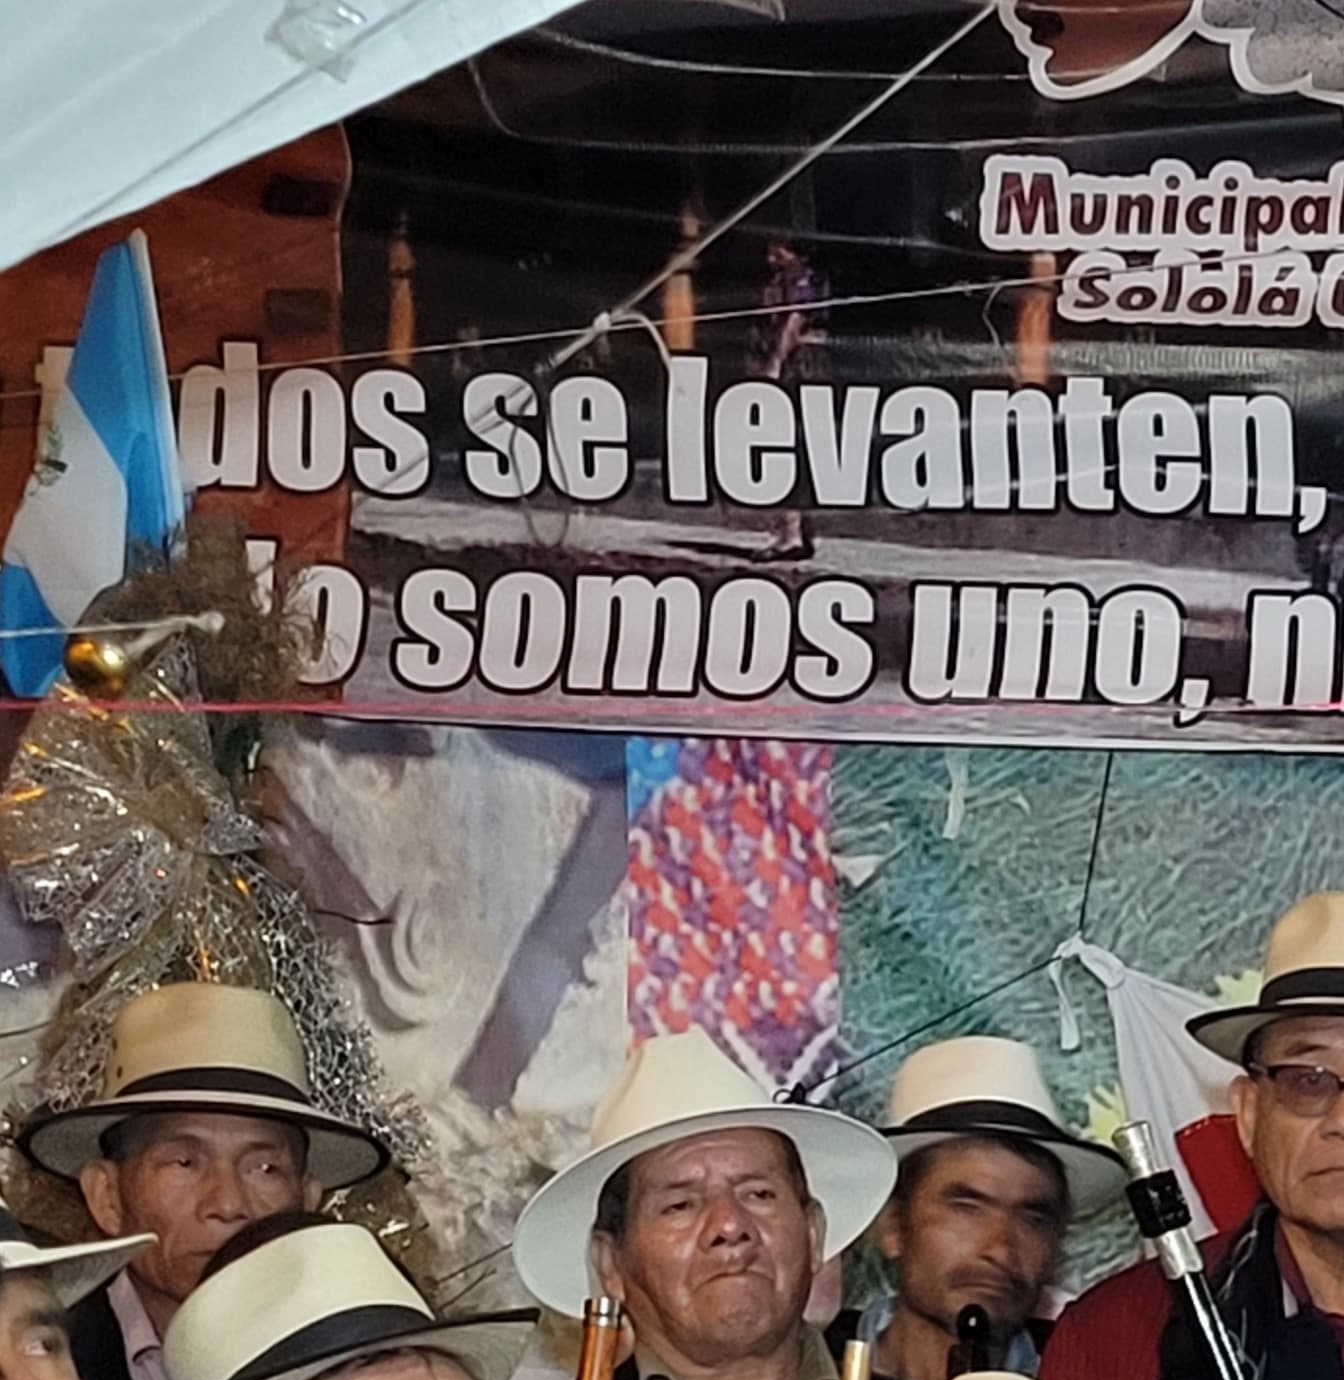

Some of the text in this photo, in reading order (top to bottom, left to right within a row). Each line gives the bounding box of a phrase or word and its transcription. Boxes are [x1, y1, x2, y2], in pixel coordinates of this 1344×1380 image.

[1070, 262, 1304, 318] Sololá
[463, 372, 628, 498] se
[666, 356, 1328, 532] levanten,
[398, 566, 876, 699] somos
[907, 584, 1209, 724] uno,
